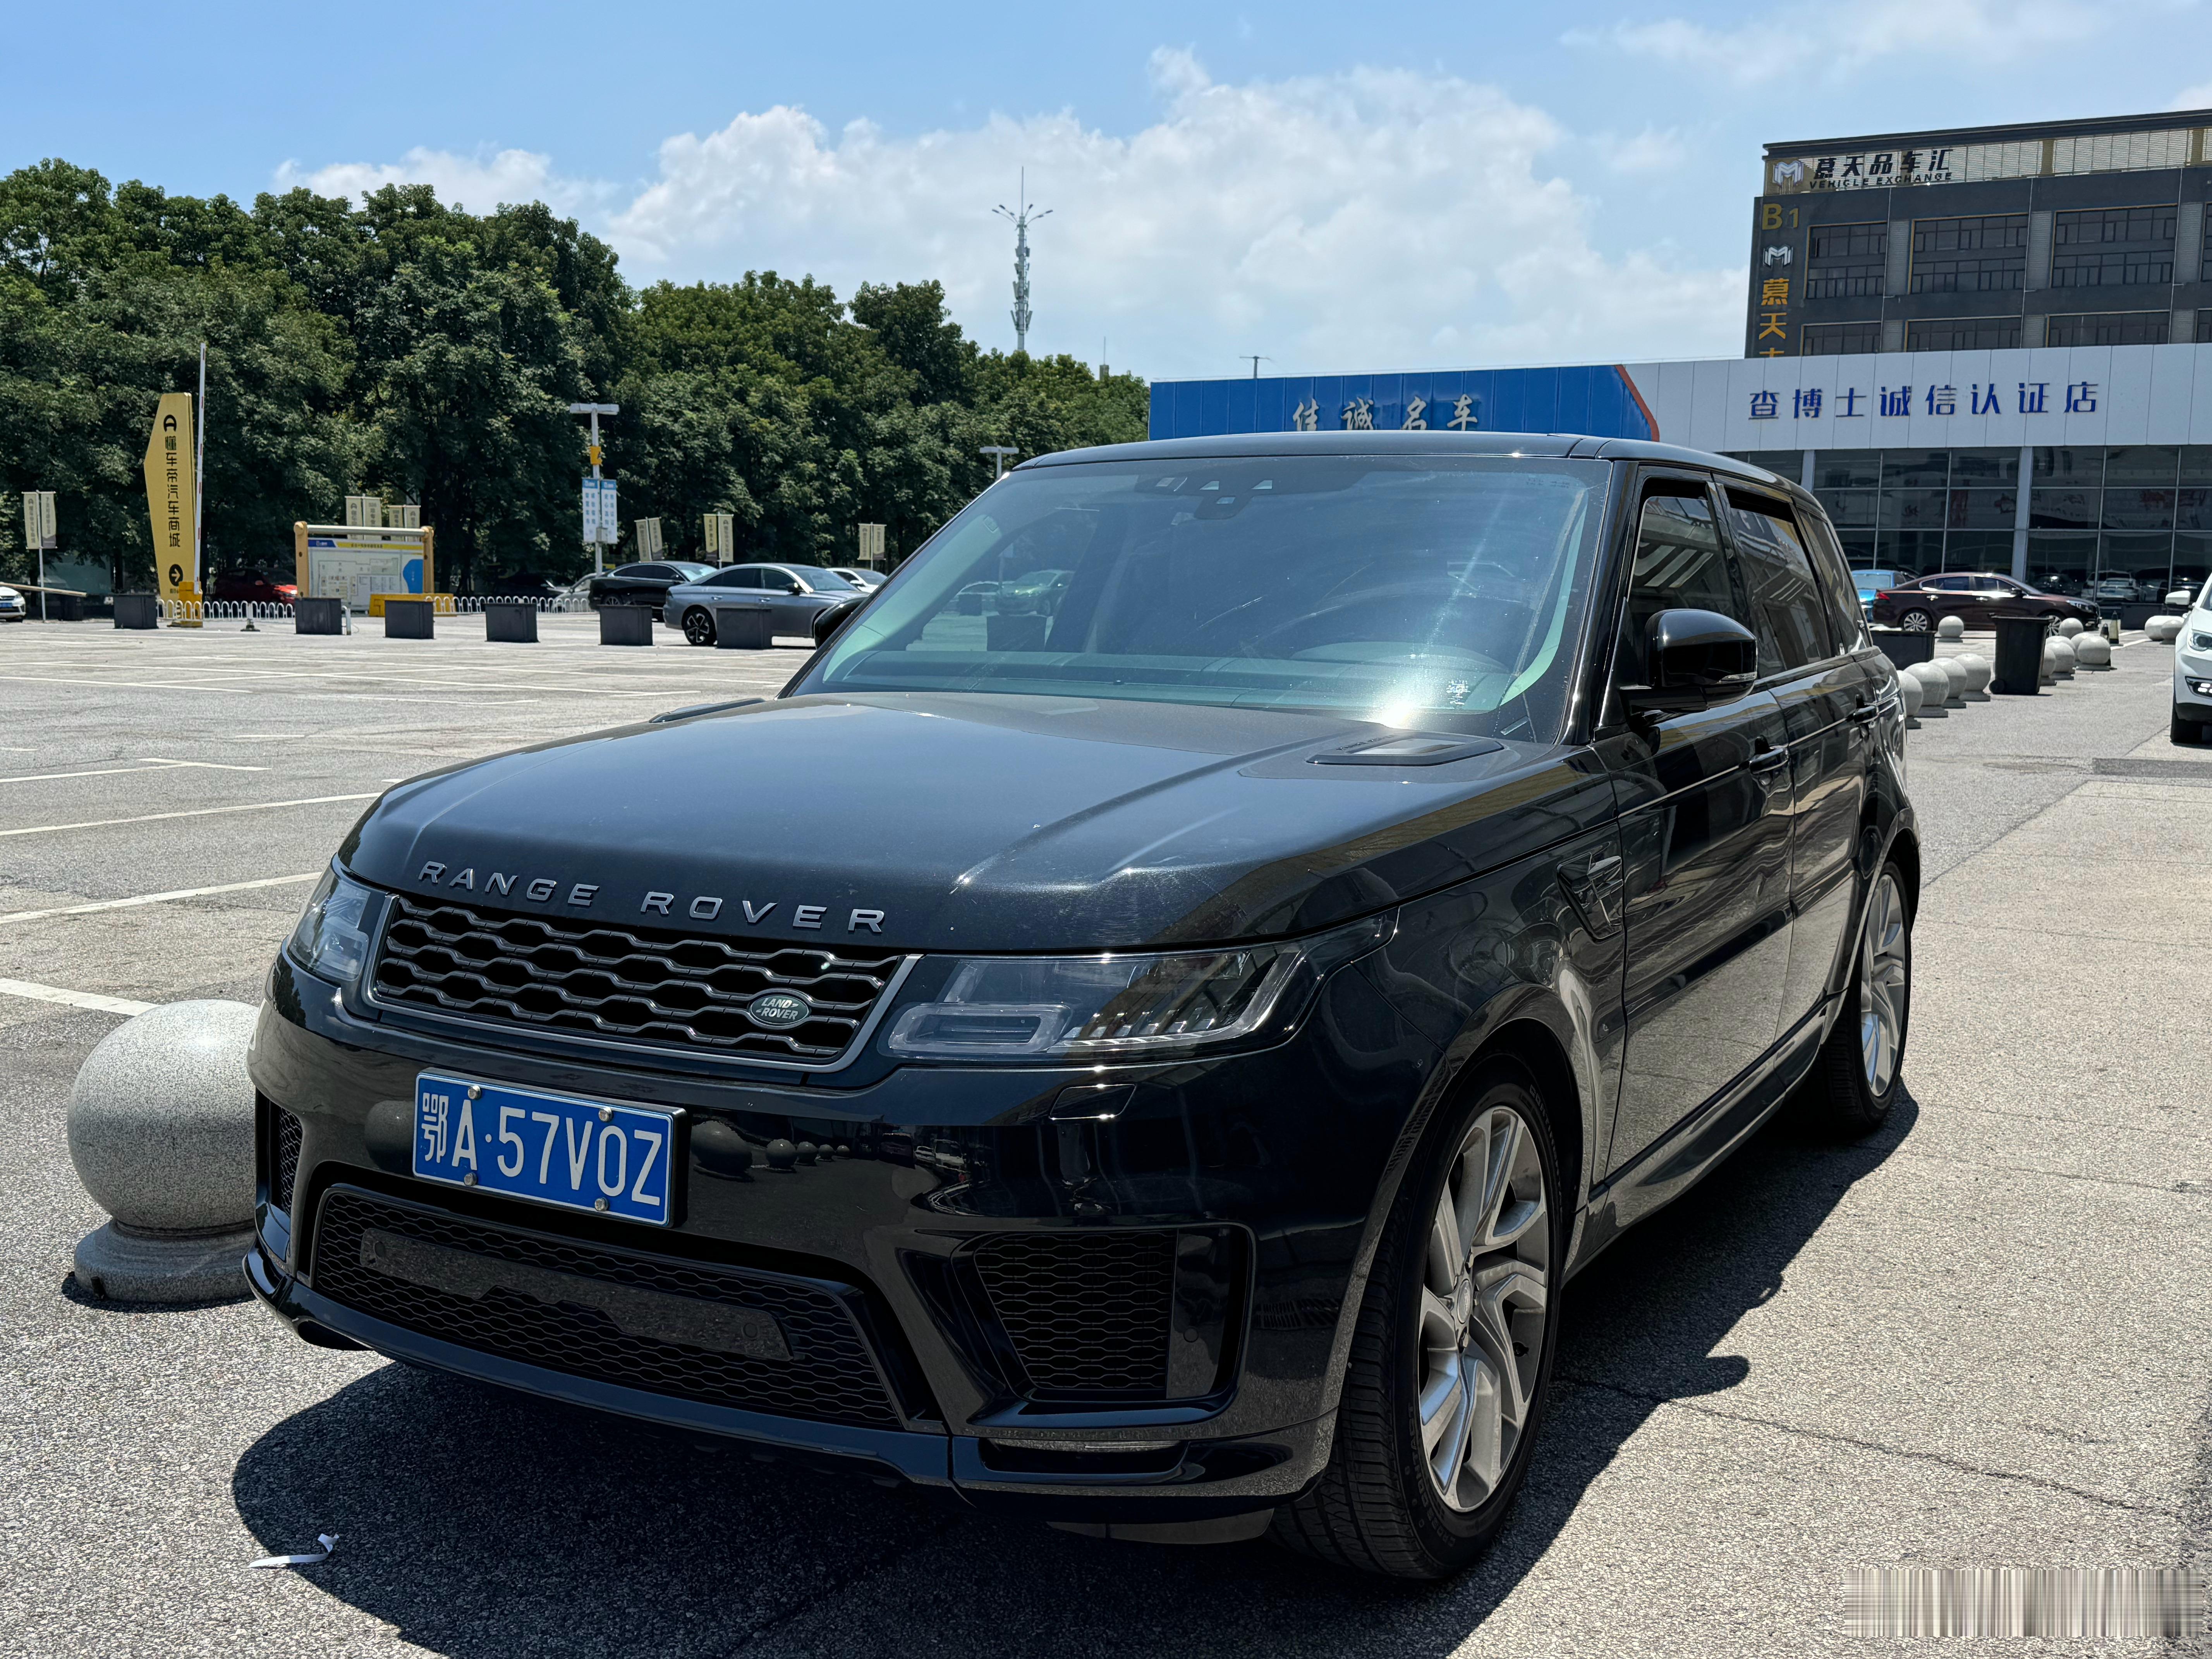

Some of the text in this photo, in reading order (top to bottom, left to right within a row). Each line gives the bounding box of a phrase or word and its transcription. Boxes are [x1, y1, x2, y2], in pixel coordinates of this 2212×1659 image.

[1809, 172, 1952, 189] VEHICLE EXCHANGE
[1762, 203, 1799, 230] B1
[1293, 393, 1478, 431] 佳诚名车
[1748, 381, 2099, 420] 查博士诚信认证店
[165, 436, 180, 548] 懂车帝汽车商城
[418, 860, 885, 933] RANGE ROVER
[761, 998, 792, 1008] LAND
[761, 1007, 798, 1020] ROVER
